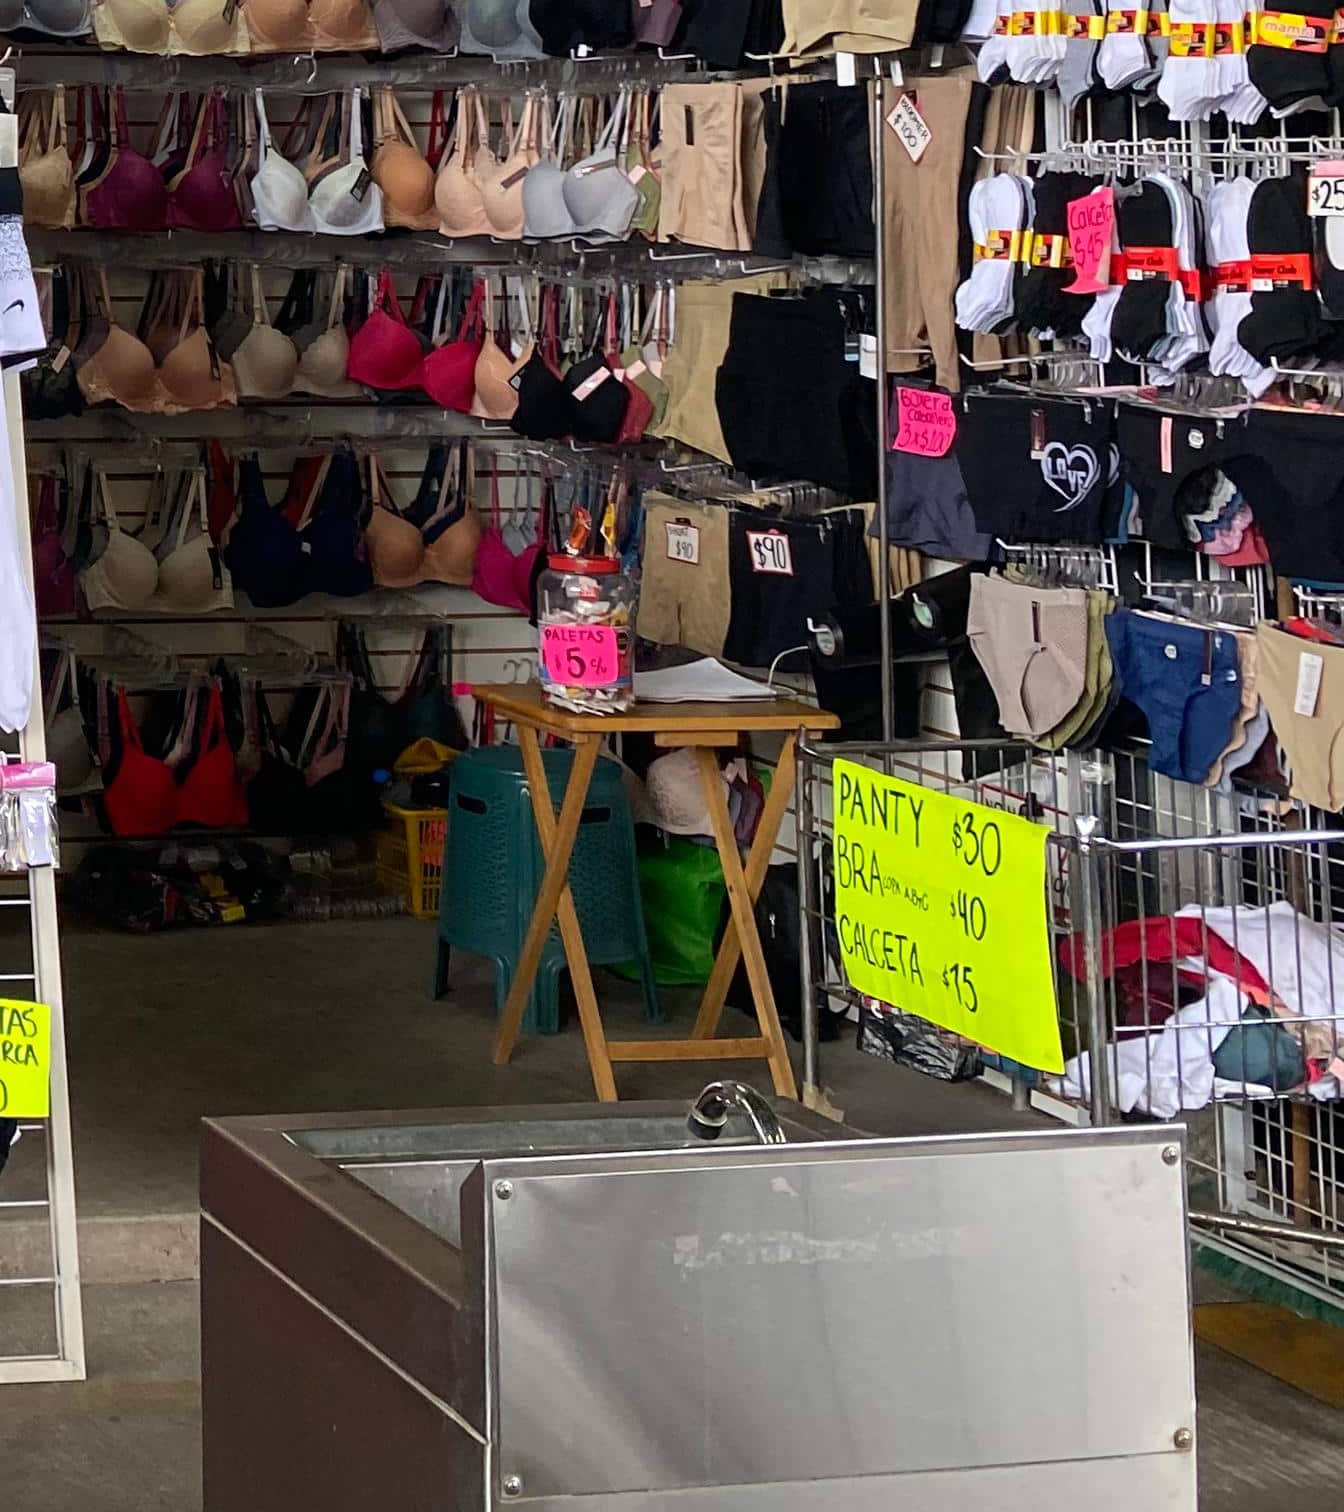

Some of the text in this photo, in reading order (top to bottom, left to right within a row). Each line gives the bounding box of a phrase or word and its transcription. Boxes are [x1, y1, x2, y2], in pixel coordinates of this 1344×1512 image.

[753, 536, 787, 570] $90
[544, 628, 604, 643] PALETAS
[840, 772, 1001, 876] PANTY $30
[837, 834, 884, 897] BRA
[950, 889, 986, 941] $40
[839, 914, 978, 1013] CALCETA $15
